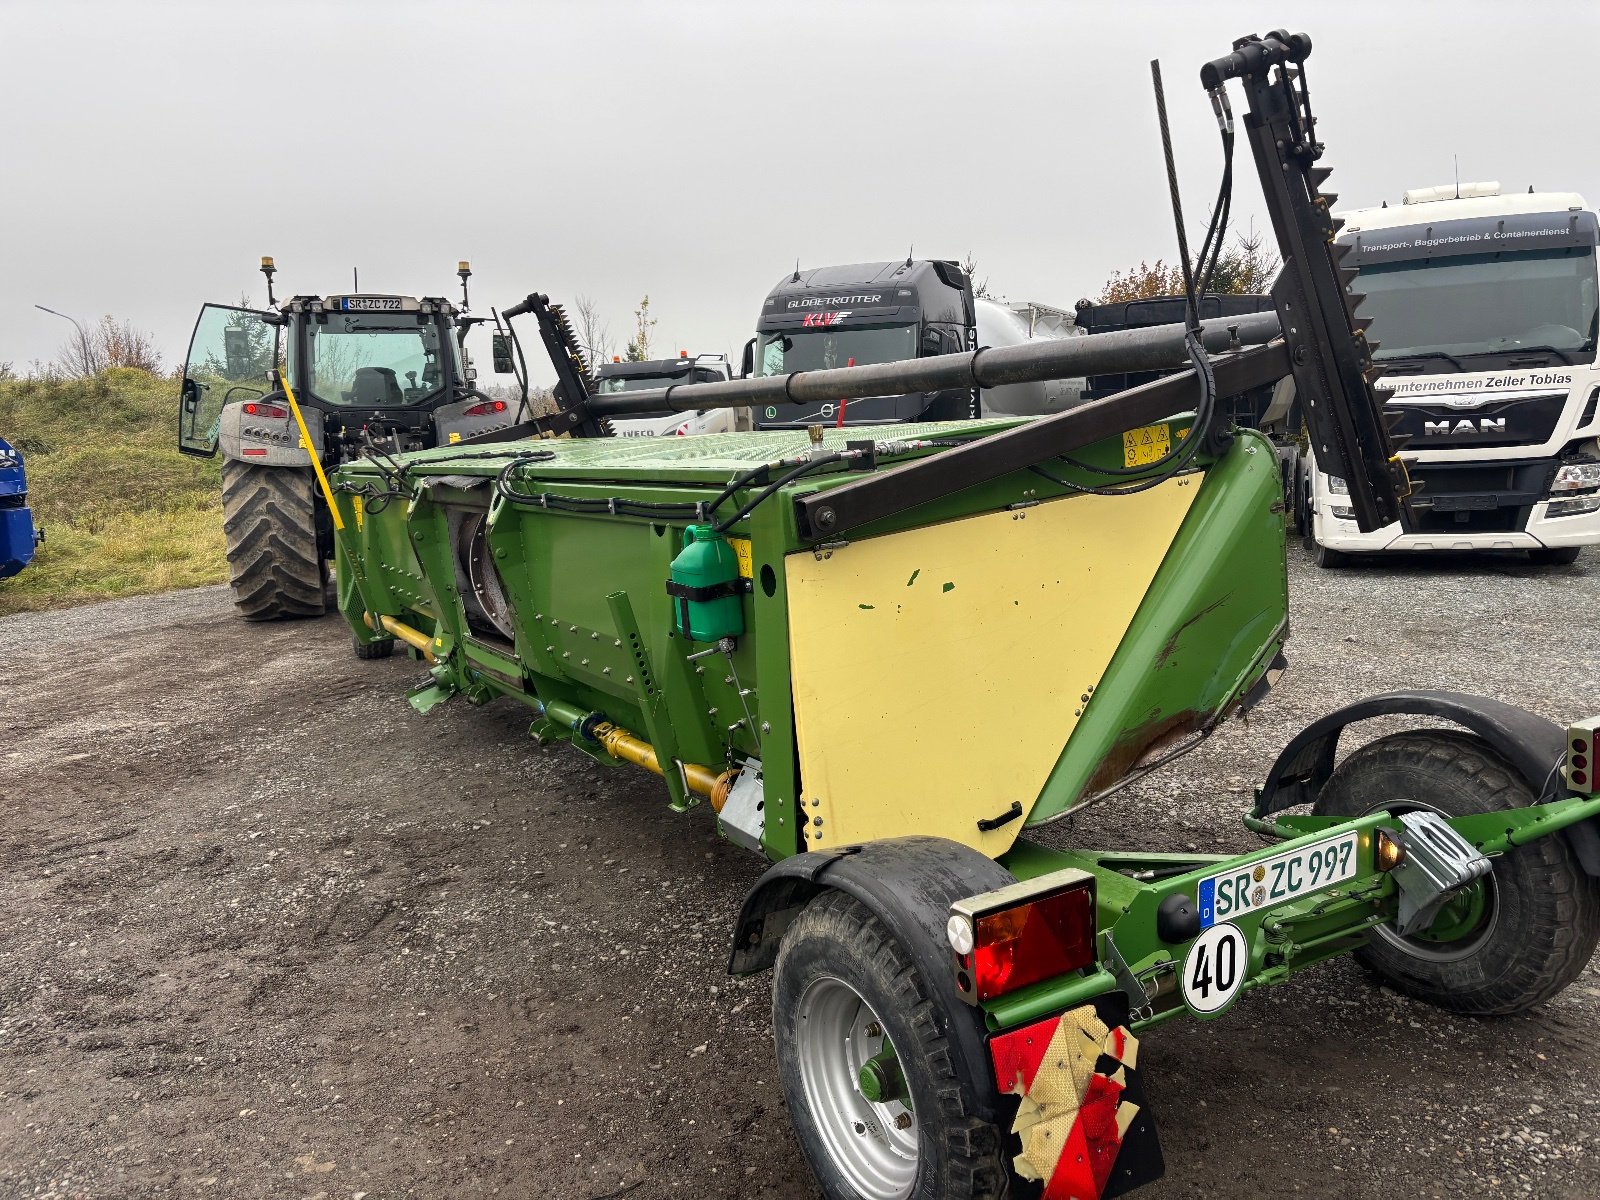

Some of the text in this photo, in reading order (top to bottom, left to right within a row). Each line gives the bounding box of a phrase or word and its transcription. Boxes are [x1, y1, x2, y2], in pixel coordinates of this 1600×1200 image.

[1414, 233, 1481, 247] Baggerbetrieb
[1493, 227, 1570, 239] Containerdienst
[349, 299, 362, 309] SR
[367, 299, 381, 309] ZC
[382, 299, 401, 309] 722
[787, 294, 882, 309] GLOBETROTTER
[1485, 375, 1526, 388] Zeiler
[1529, 373, 1572, 385] Tobias
[622, 429, 655, 438] IVECO
[1424, 417, 1506, 436] MAN
[1216, 872, 1251, 916] SR
[1269, 856, 1303, 900] ZC
[1308, 839, 1354, 887] 997
[1191, 934, 1236, 999] 40
